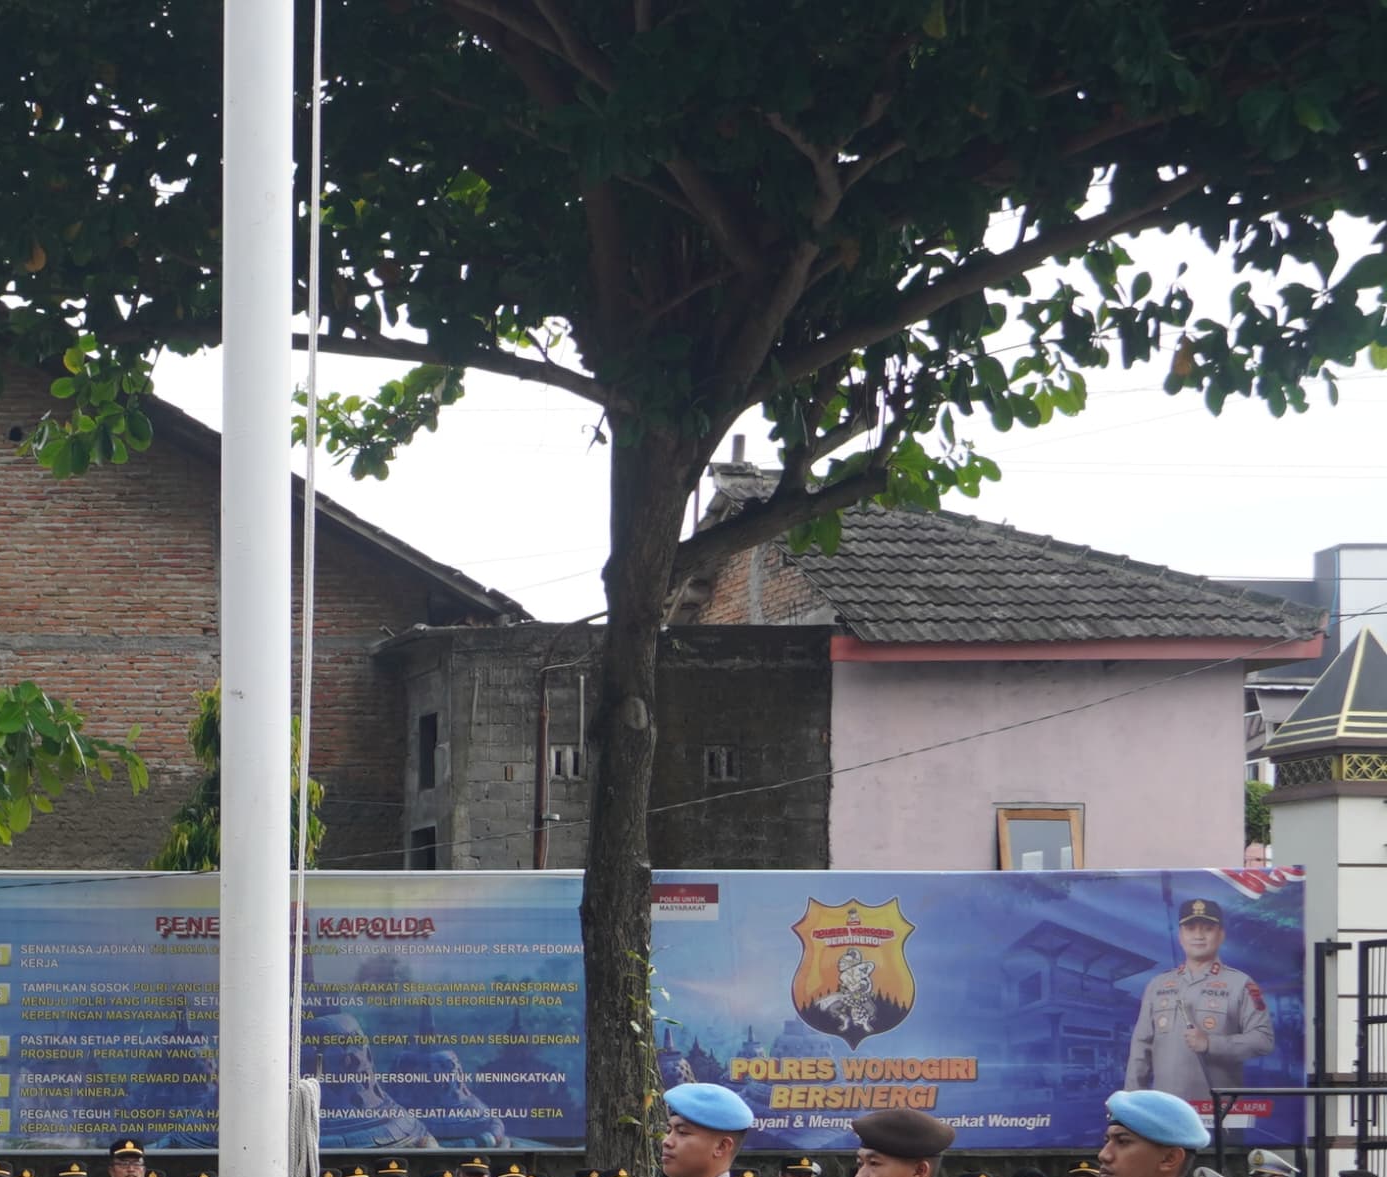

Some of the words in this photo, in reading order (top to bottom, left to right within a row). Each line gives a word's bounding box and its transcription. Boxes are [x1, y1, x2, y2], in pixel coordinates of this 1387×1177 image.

[318, 917, 435, 938] KAPOLDA
[20, 944, 93, 954] SENANTIASA
[96, 944, 145, 954] JADIKAN
[340, 944, 389, 954] SEBAGAI
[394, 944, 450, 954] PEDOMAN
[493, 944, 528, 954] SERTA
[20, 959, 59, 968] KERJA
[22, 983, 87, 992] TAMPILKAN
[90, 983, 130, 992] SOSOK
[134, 983, 168, 992] POLRI
[170, 983, 201, 992] YANG
[323, 983, 399, 992] MASYARAKAT
[403, 983, 485, 992] SEBAGAIMANA
[490, 983, 578, 992] TRANSFORMASI
[22, 997, 69, 1006] MENUJU
[72, 997, 106, 1006] POLRI
[110, 997, 140, 1006] YANG
[324, 997, 363, 1006] TUGAS
[367, 997, 400, 1006] POLRI
[404, 997, 442, 1006] HARUS
[446, 997, 528, 1006] BERORIENTASI
[532, 997, 562, 1006] PADA
[22, 1010, 102, 1020] KEPENTINGAN
[21, 1036, 77, 1045] PASTIKAN
[80, 1036, 121, 1045] SETIAP
[124, 1036, 209, 1045] PELAKSANAAN
[324, 1035, 370, 1045] SECARA
[414, 1035, 457, 1045] TUNTAS
[461, 1035, 484, 1045] DAN
[488, 1035, 528, 1045] SESUAI
[531, 1035, 580, 1045] DENGAN
[21, 1049, 84, 1058] PROSEDUR
[94, 1049, 162, 1058] PERATURAN
[166, 1049, 196, 1058] YANG
[730, 1057, 836, 1080] POLRES
[841, 1057, 977, 1080] WONOGIRI
[20, 1074, 82, 1083] TERAPKAN
[86, 1074, 127, 1083] SISTEM
[130, 1074, 179, 1083] REWARD
[183, 1074, 207, 1083] DAN
[318, 1073, 370, 1083] SELURUH
[374, 1073, 430, 1083] PERSONIL
[434, 1073, 472, 1083] UNTUK
[476, 1073, 566, 1083] MENINGKATKAN
[20, 1087, 73, 1097] MOTIVASI
[770, 1085, 938, 1109] BERSINERGI
[20, 1109, 69, 1119] PEGANG
[72, 1109, 111, 1119] TEGUH
[114, 1109, 165, 1119] FILOSOFI
[169, 1109, 203, 1119] SATYA
[320, 1109, 405, 1119] BHAYANGKARA
[408, 1109, 445, 1119] SEJATI
[448, 1109, 480, 1119] AKAN
[483, 1109, 527, 1119] SELALU
[531, 1109, 563, 1119] SETIA
[748, 1115, 789, 1130] ayani
[793, 1115, 804, 1128] &
[939, 1115, 984, 1128] arakat
[988, 1115, 1051, 1130] Wonogiri
[20, 1123, 66, 1133] KEPADA
[68, 1123, 117, 1133] NEGARA
[120, 1123, 144, 1133] DAN
